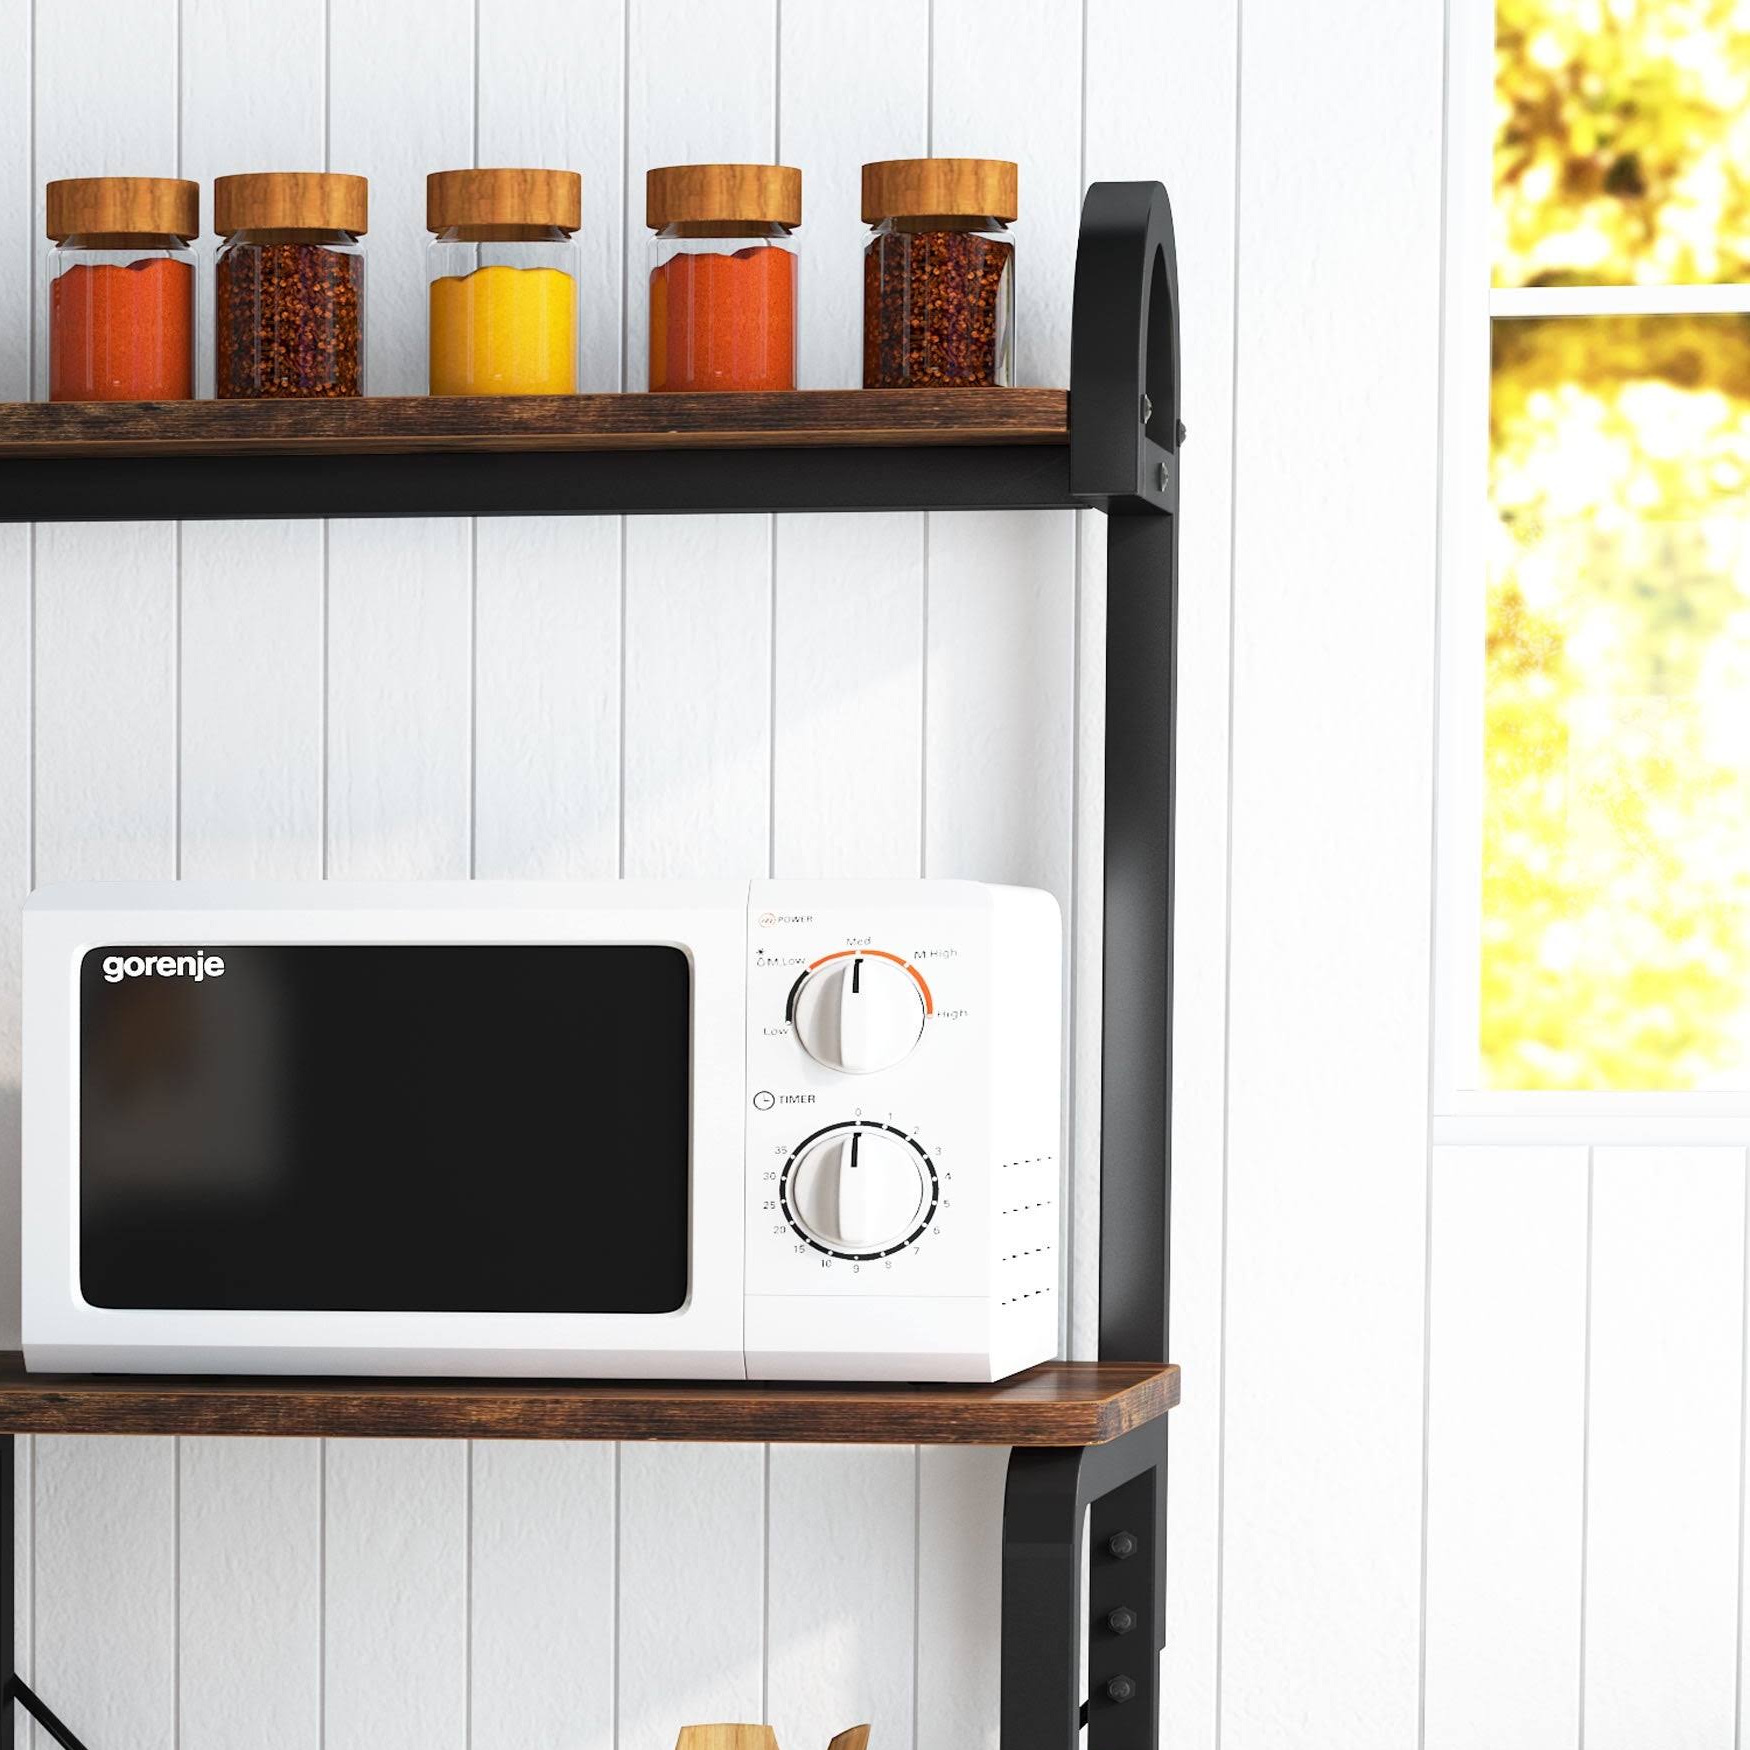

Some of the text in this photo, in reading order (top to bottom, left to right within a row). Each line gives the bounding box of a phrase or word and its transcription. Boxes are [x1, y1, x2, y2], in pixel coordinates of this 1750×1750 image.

[778, 915, 813, 924] POWER
[846, 937, 871, 946] Med
[102, 950, 225, 983] gorenje
[937, 1010, 968, 1020] High
[763, 1027, 789, 1036] Low
[779, 1095, 816, 1105] TIMER
[774, 1146, 788, 1155] 35
[763, 1201, 776, 1210] 25
[794, 1245, 806, 1254] 15
[821, 1259, 832, 1268] 10
